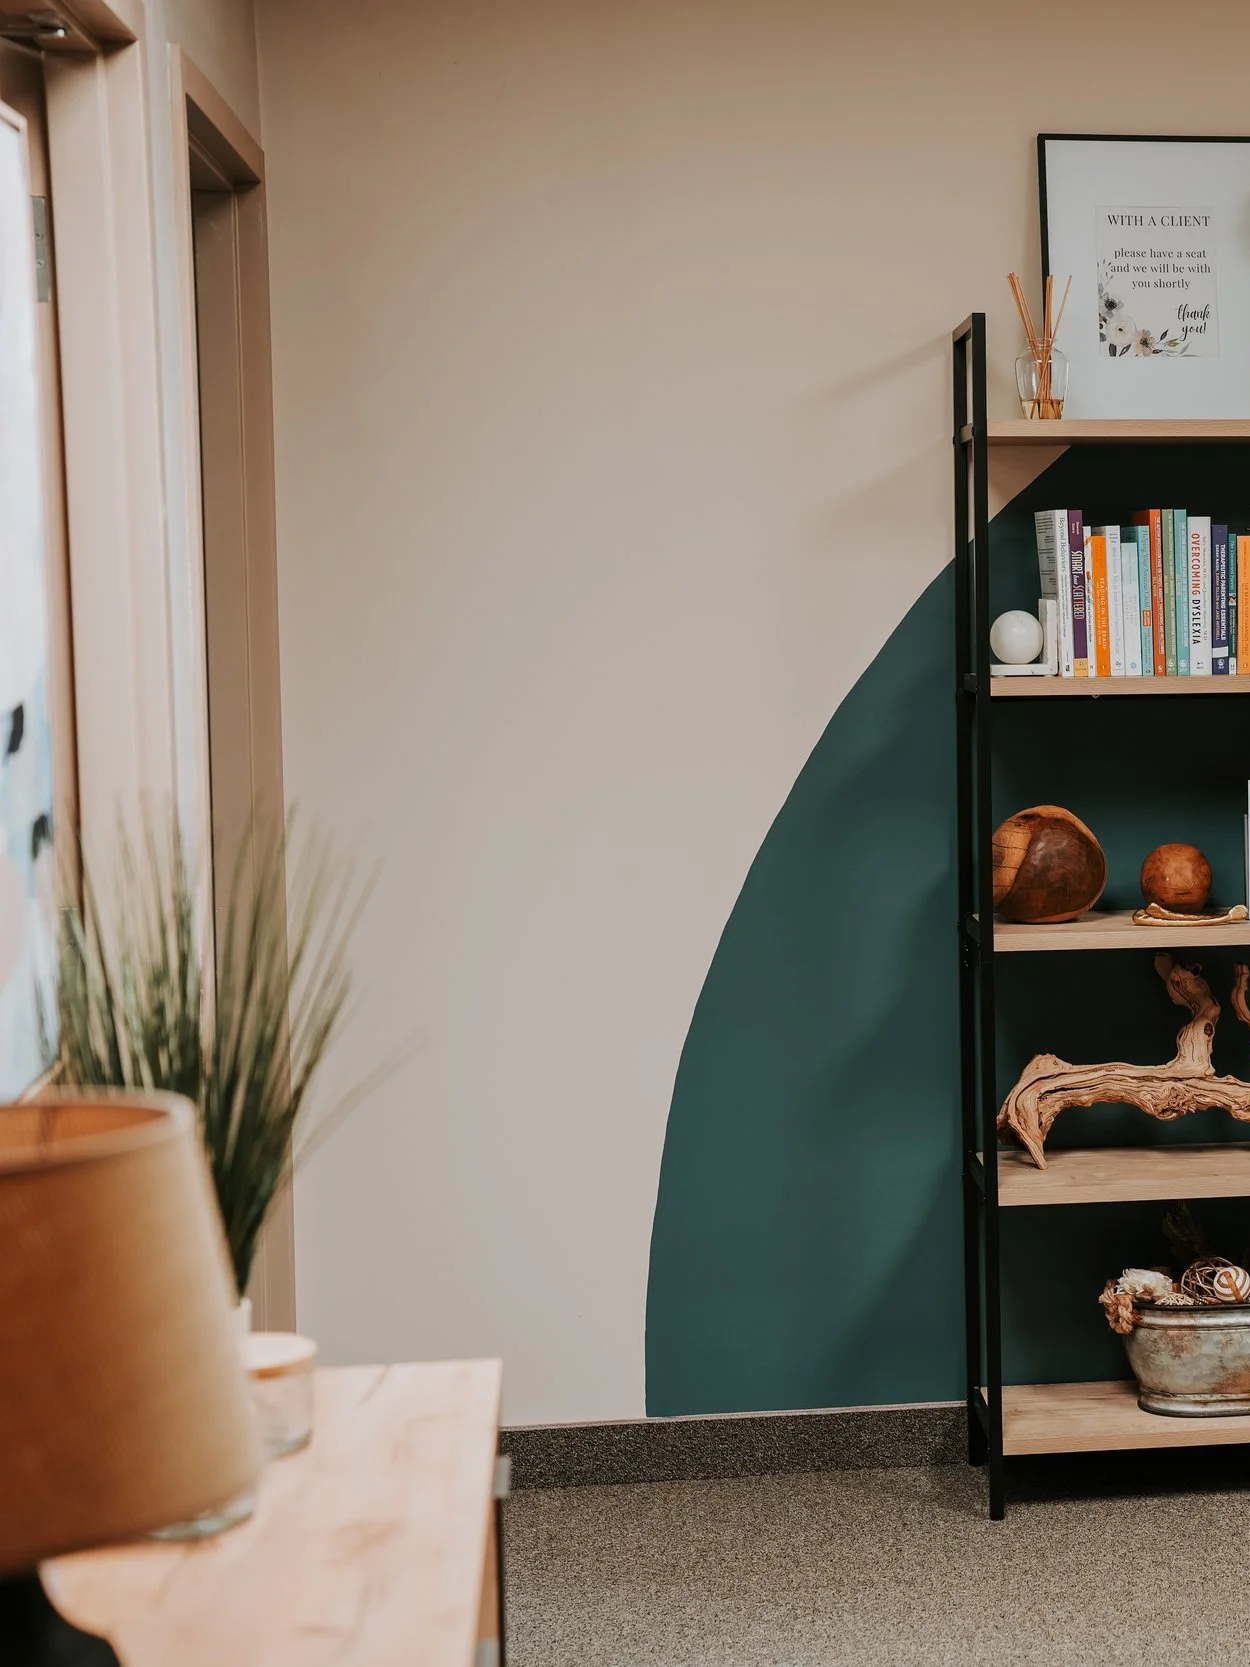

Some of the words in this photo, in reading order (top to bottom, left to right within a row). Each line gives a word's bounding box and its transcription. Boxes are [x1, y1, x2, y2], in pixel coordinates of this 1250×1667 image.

[1107, 215, 1143, 226] WITH
[1148, 216, 1157, 226] A
[1161, 216, 1211, 227] CLIENT
[1114, 248, 1147, 259] please
[1150, 248, 1173, 258] have
[1185, 249, 1206, 258] seat
[1110, 263, 1129, 272] and
[1133, 265, 1147, 273] we
[1150, 264, 1169, 273] will
[1172, 264, 1185, 273] be
[1188, 264, 1211, 273] with
[1132, 281, 1150, 289] you
[1153, 279, 1190, 290] shortly
[1177, 304, 1210, 321] thank
[1180, 322, 1206, 341] you!
[1071, 550, 1083, 575] SMART
[1191, 533, 1201, 595] OVERCOMING
[1073, 585, 1085, 620] SCATTERED
[1101, 607, 1106, 615] IN
[1192, 599, 1201, 644] DYSLEXIA
